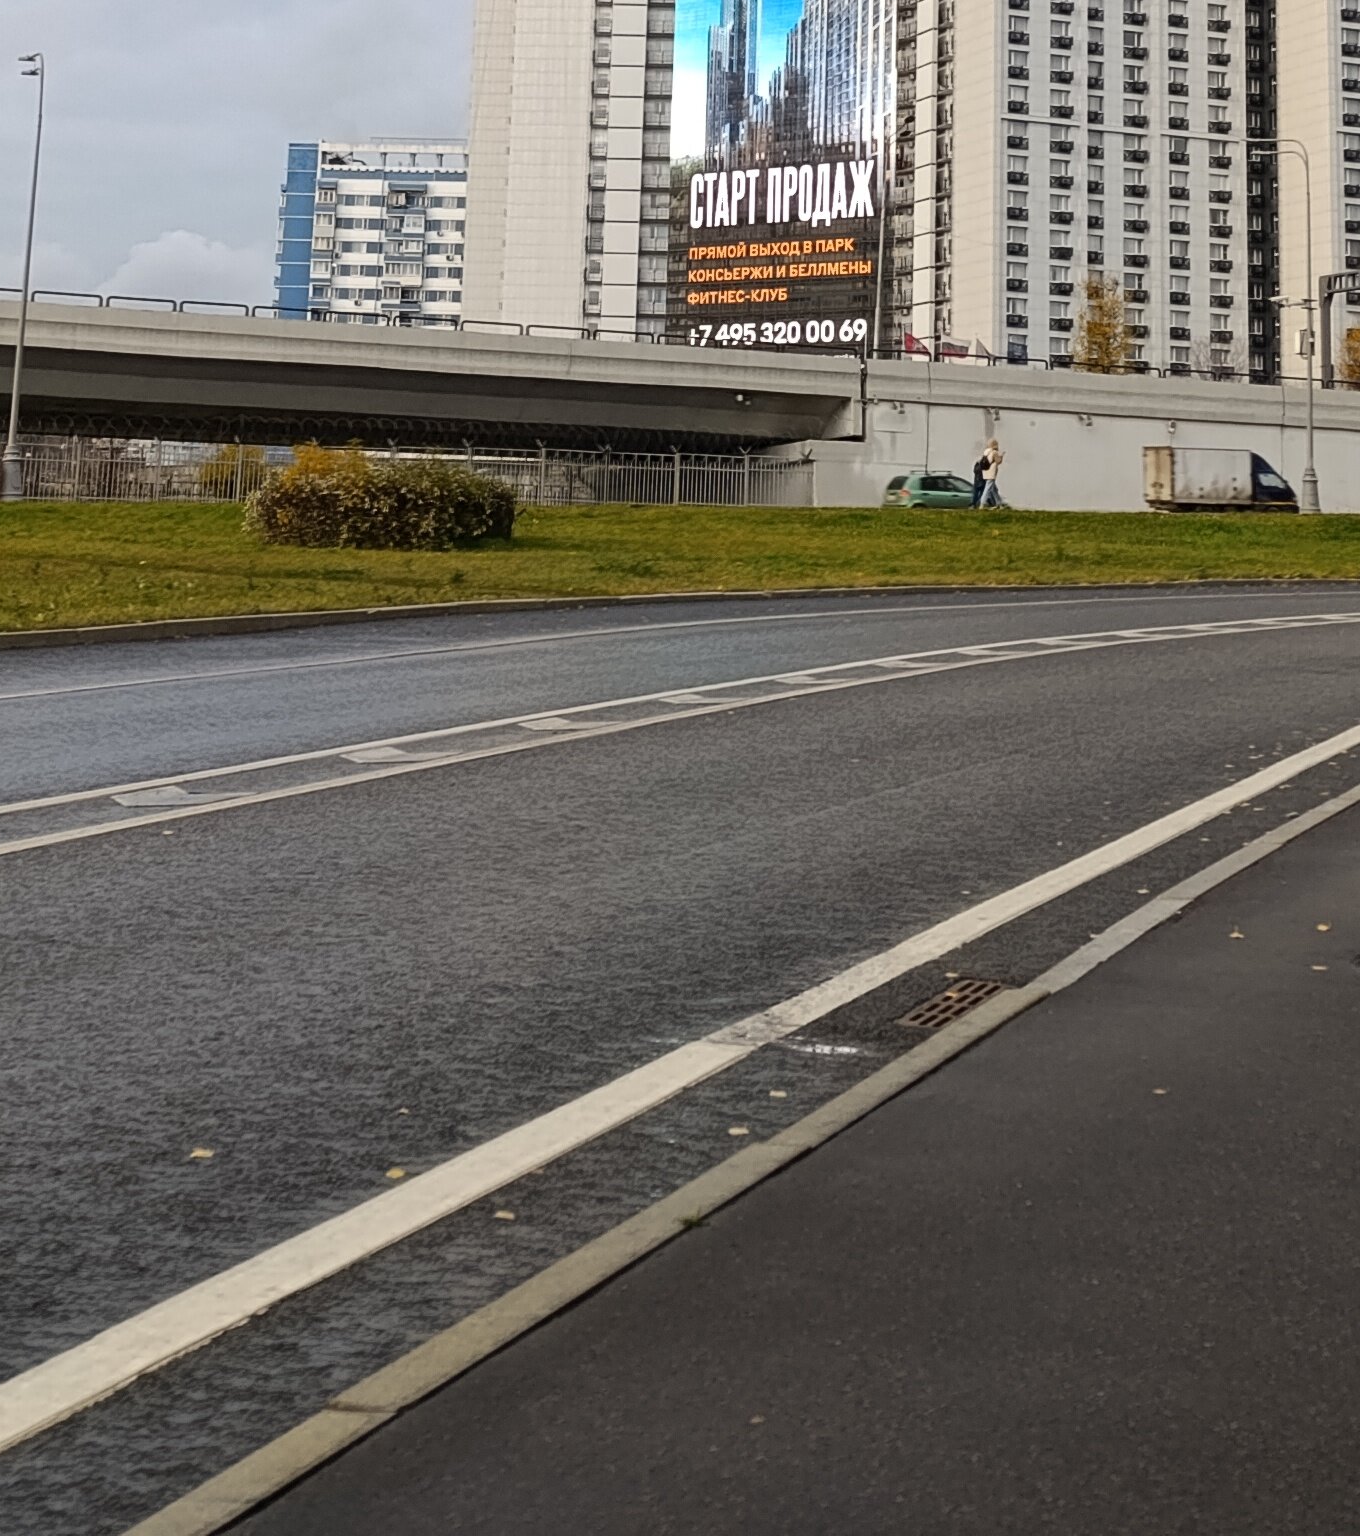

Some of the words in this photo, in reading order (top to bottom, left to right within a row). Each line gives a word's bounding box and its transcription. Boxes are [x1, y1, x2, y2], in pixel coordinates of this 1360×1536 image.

[690, 169, 760, 229] СТАРТ
[766, 160, 875, 227] ПРОДАЖ
[688, 241, 746, 261] ПРЯМОЙ
[749, 240, 801, 258] ВЫХОД
[804, 241, 813, 254] В
[815, 237, 855, 253] ПАРК
[688, 265, 773, 283] КОНСЬЕРЖИ
[775, 265, 787, 279] И
[789, 260, 872, 278] БЕЛЛМЕНЫ
[687, 287, 788, 306] ФИТНЕС-КЛУБ
[689, 324, 713, 347] +7
[715, 322, 757, 346] 495
[759, 321, 801, 344] 320
[805, 319, 835, 343] 00
[839, 318, 868, 342] 69
